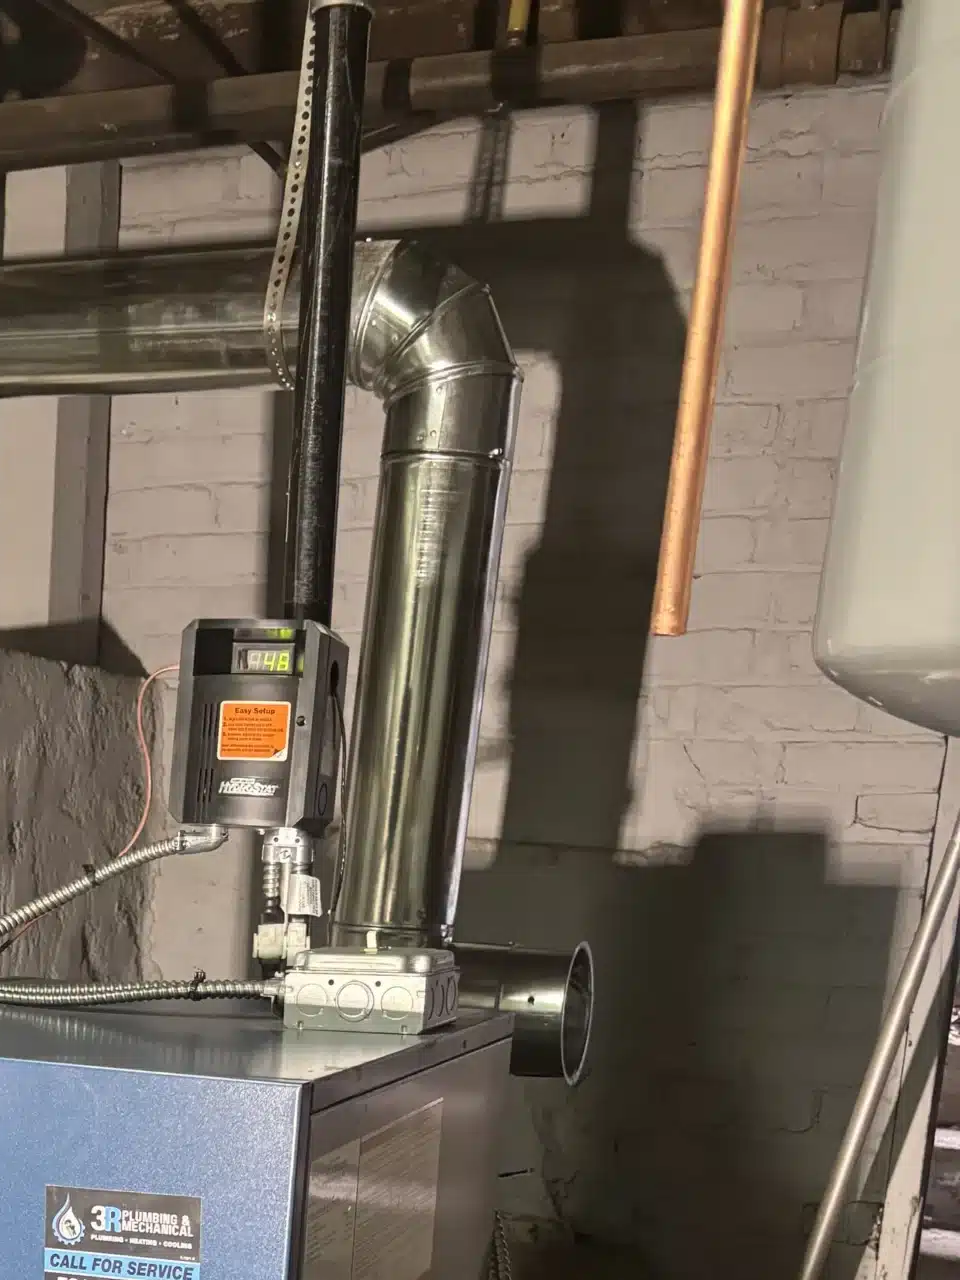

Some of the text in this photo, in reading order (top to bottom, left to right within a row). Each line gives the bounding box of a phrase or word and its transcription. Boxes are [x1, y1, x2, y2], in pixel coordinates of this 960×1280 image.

[235, 707, 276, 715] Easy Setup
[91, 1205, 191, 1233] 3R PLUMBING &
[121, 1220, 194, 1238] MECHANICAL
[90, 1234, 193, 1250] PLUMBING HEATING COOLING
[50, 1253, 194, 1280] CALL FOR SERVICE
